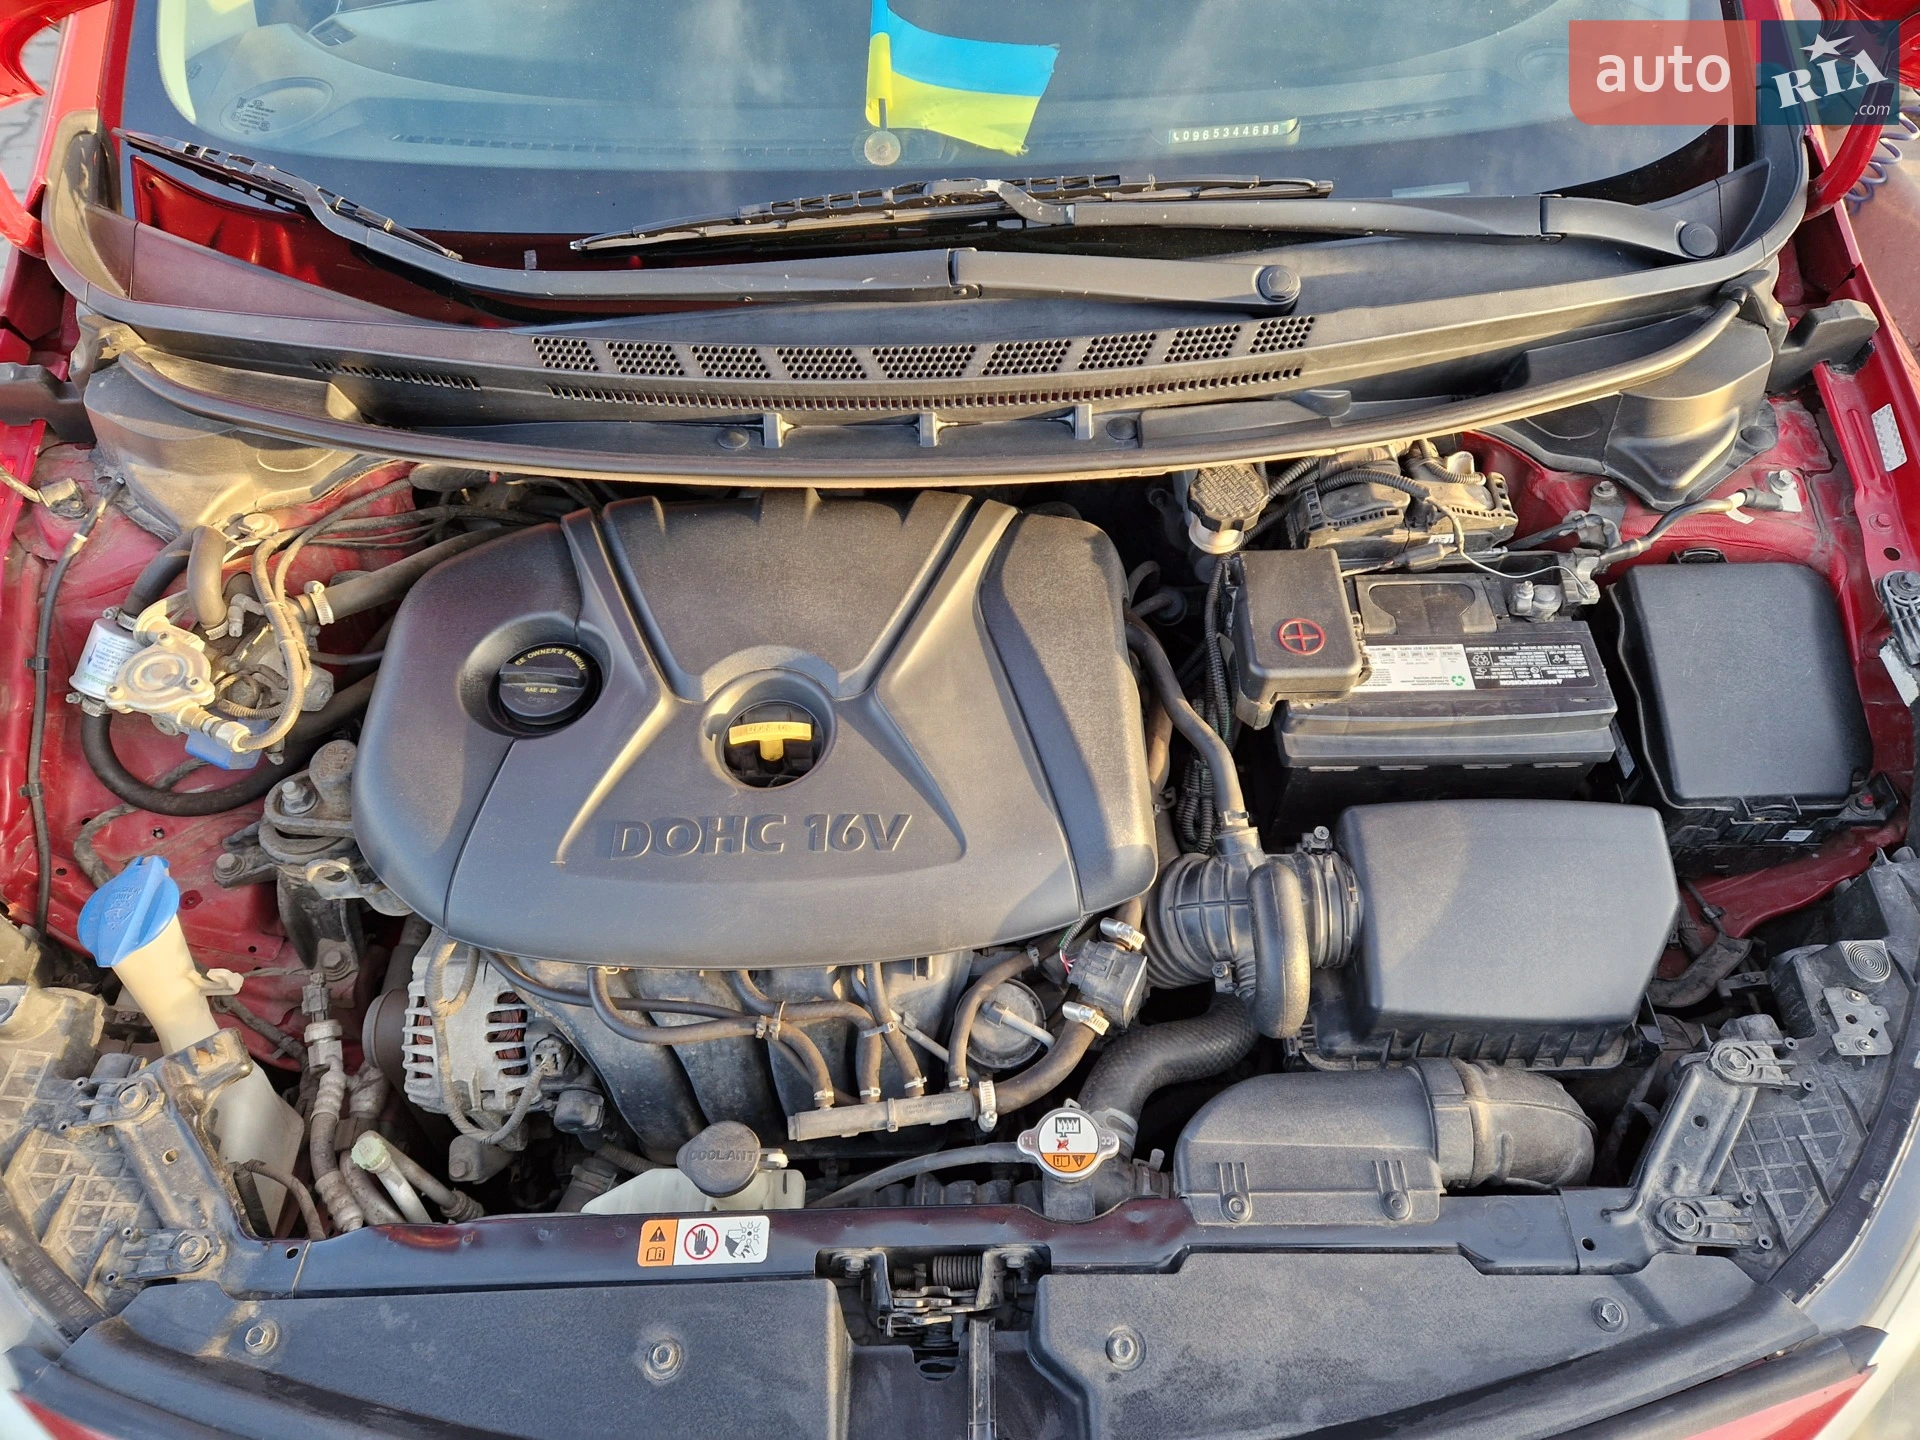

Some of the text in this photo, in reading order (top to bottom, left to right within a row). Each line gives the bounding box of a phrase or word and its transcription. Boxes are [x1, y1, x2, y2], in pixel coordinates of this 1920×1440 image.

[1183, 124, 1279, 141] 0965344688
[515, 648, 586, 670] EE OWNER'S MANUA
[610, 814, 912, 860] DOHC 16V
[690, 1149, 756, 1162] COOLANT
